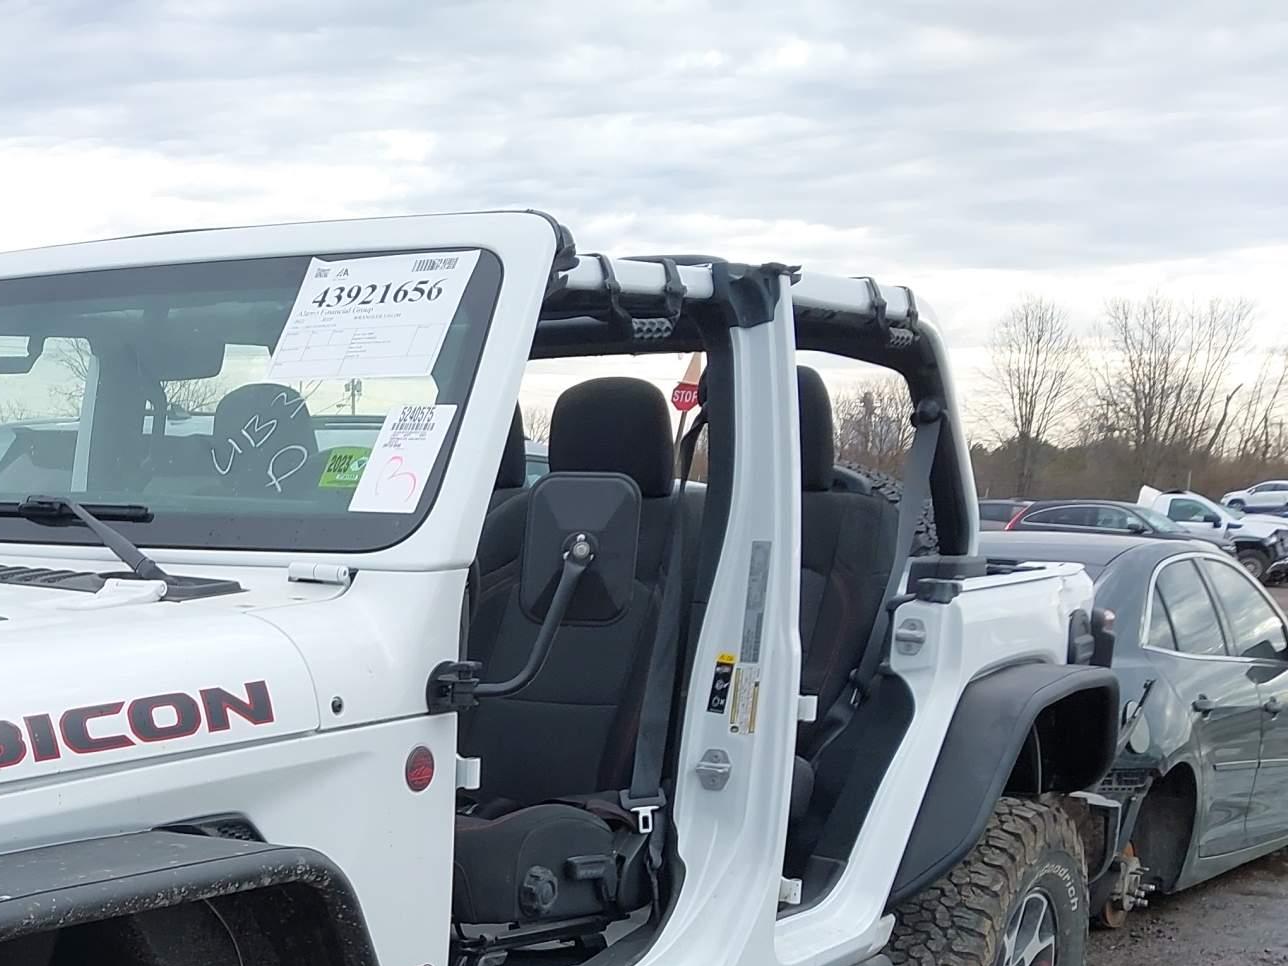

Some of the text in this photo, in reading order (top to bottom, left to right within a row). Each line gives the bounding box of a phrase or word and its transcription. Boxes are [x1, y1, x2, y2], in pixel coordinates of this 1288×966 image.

[312, 277, 448, 309] 43921656
[398, 406, 437, 423] 5240575
[327, 454, 353, 473] 2023
